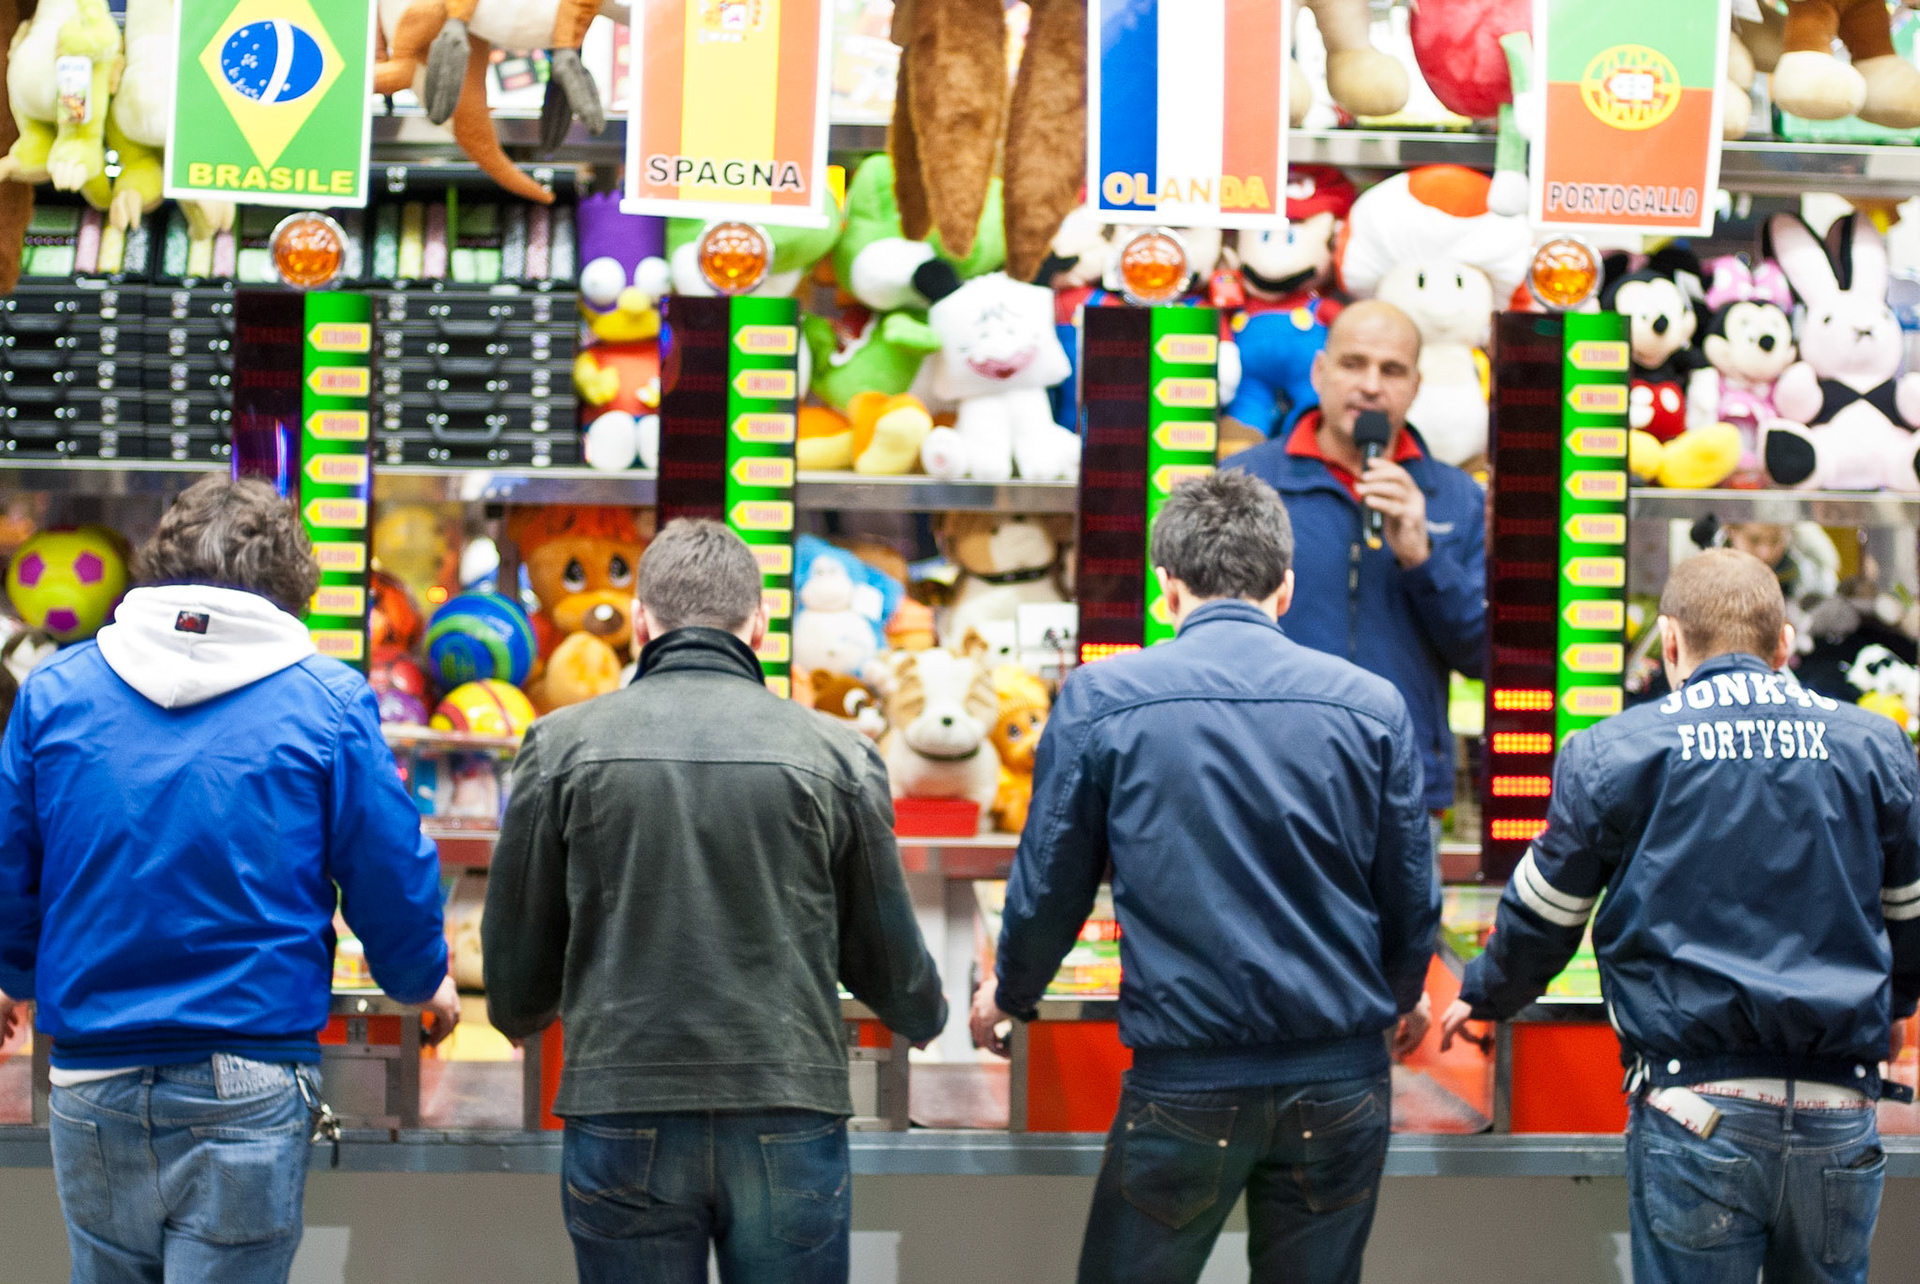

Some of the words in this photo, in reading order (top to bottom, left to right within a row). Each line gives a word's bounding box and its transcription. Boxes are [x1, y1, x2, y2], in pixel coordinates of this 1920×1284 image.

[188, 161, 355, 194] BRASILE
[647, 155, 805, 192] SPAGNA
[1102, 171, 1271, 209] OLANDA
[1548, 182, 1698, 218] PORTOGALLO
[1677, 719, 1829, 761] FORTYSIX
